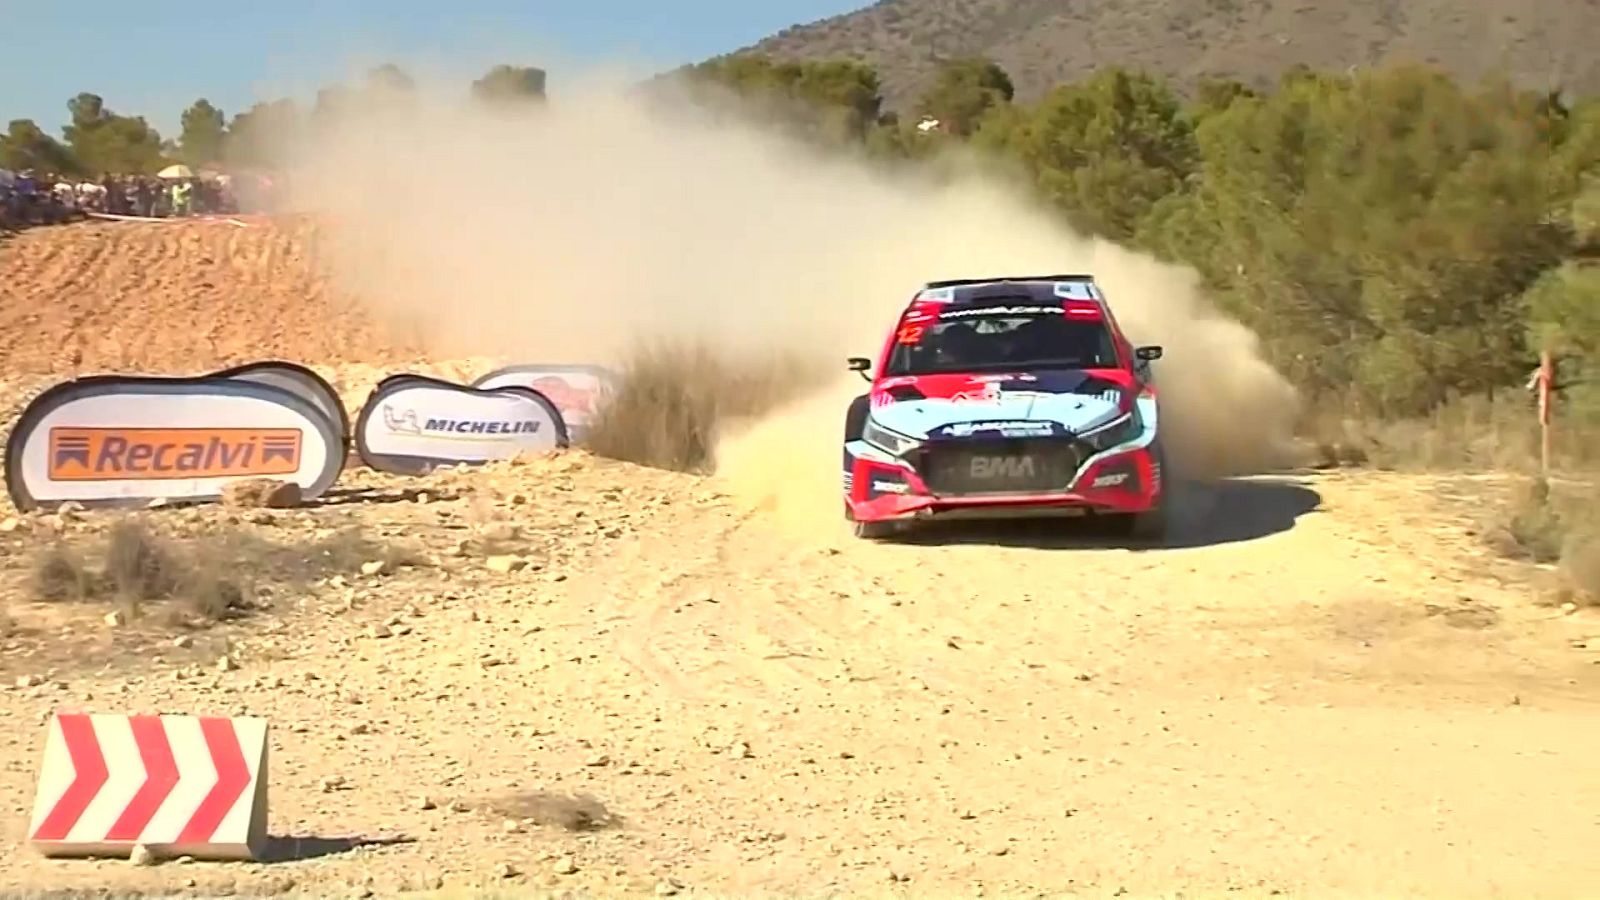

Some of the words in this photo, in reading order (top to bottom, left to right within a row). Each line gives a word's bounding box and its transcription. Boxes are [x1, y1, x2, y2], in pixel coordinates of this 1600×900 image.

[425, 418, 541, 434] MICHELIN
[94, 435, 258, 473] Recalvi
[970, 455, 1035, 478] BMA
